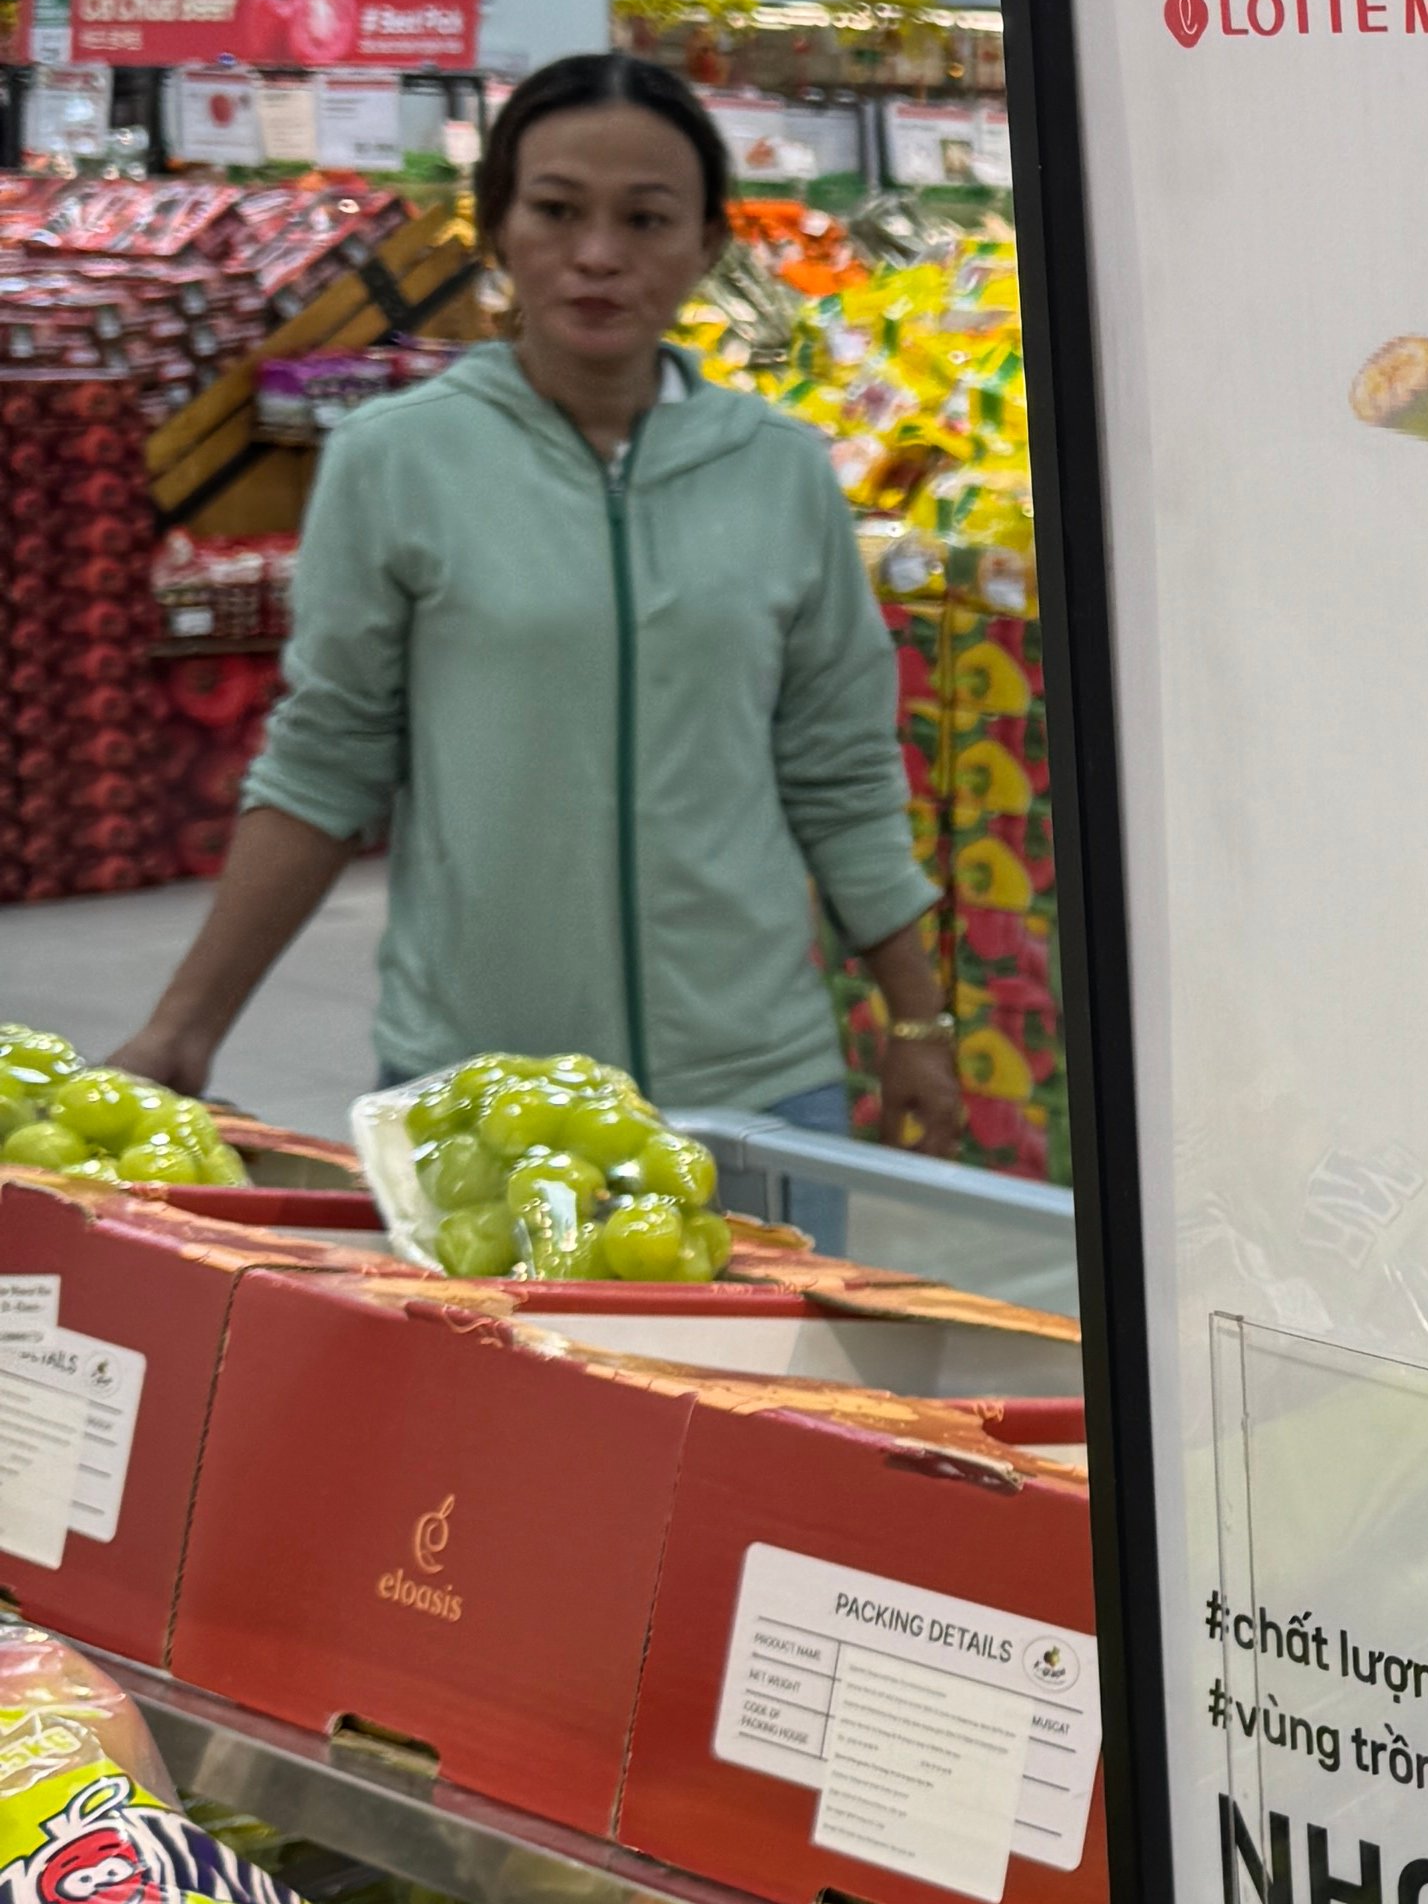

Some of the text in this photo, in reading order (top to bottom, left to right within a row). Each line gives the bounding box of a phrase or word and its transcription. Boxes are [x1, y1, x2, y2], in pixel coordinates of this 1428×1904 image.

[834, 1592, 1014, 1664] PACKING DETAILS
[1205, 1590, 1330, 1672] #chất
[1208, 1678, 1341, 1773] #vùng
